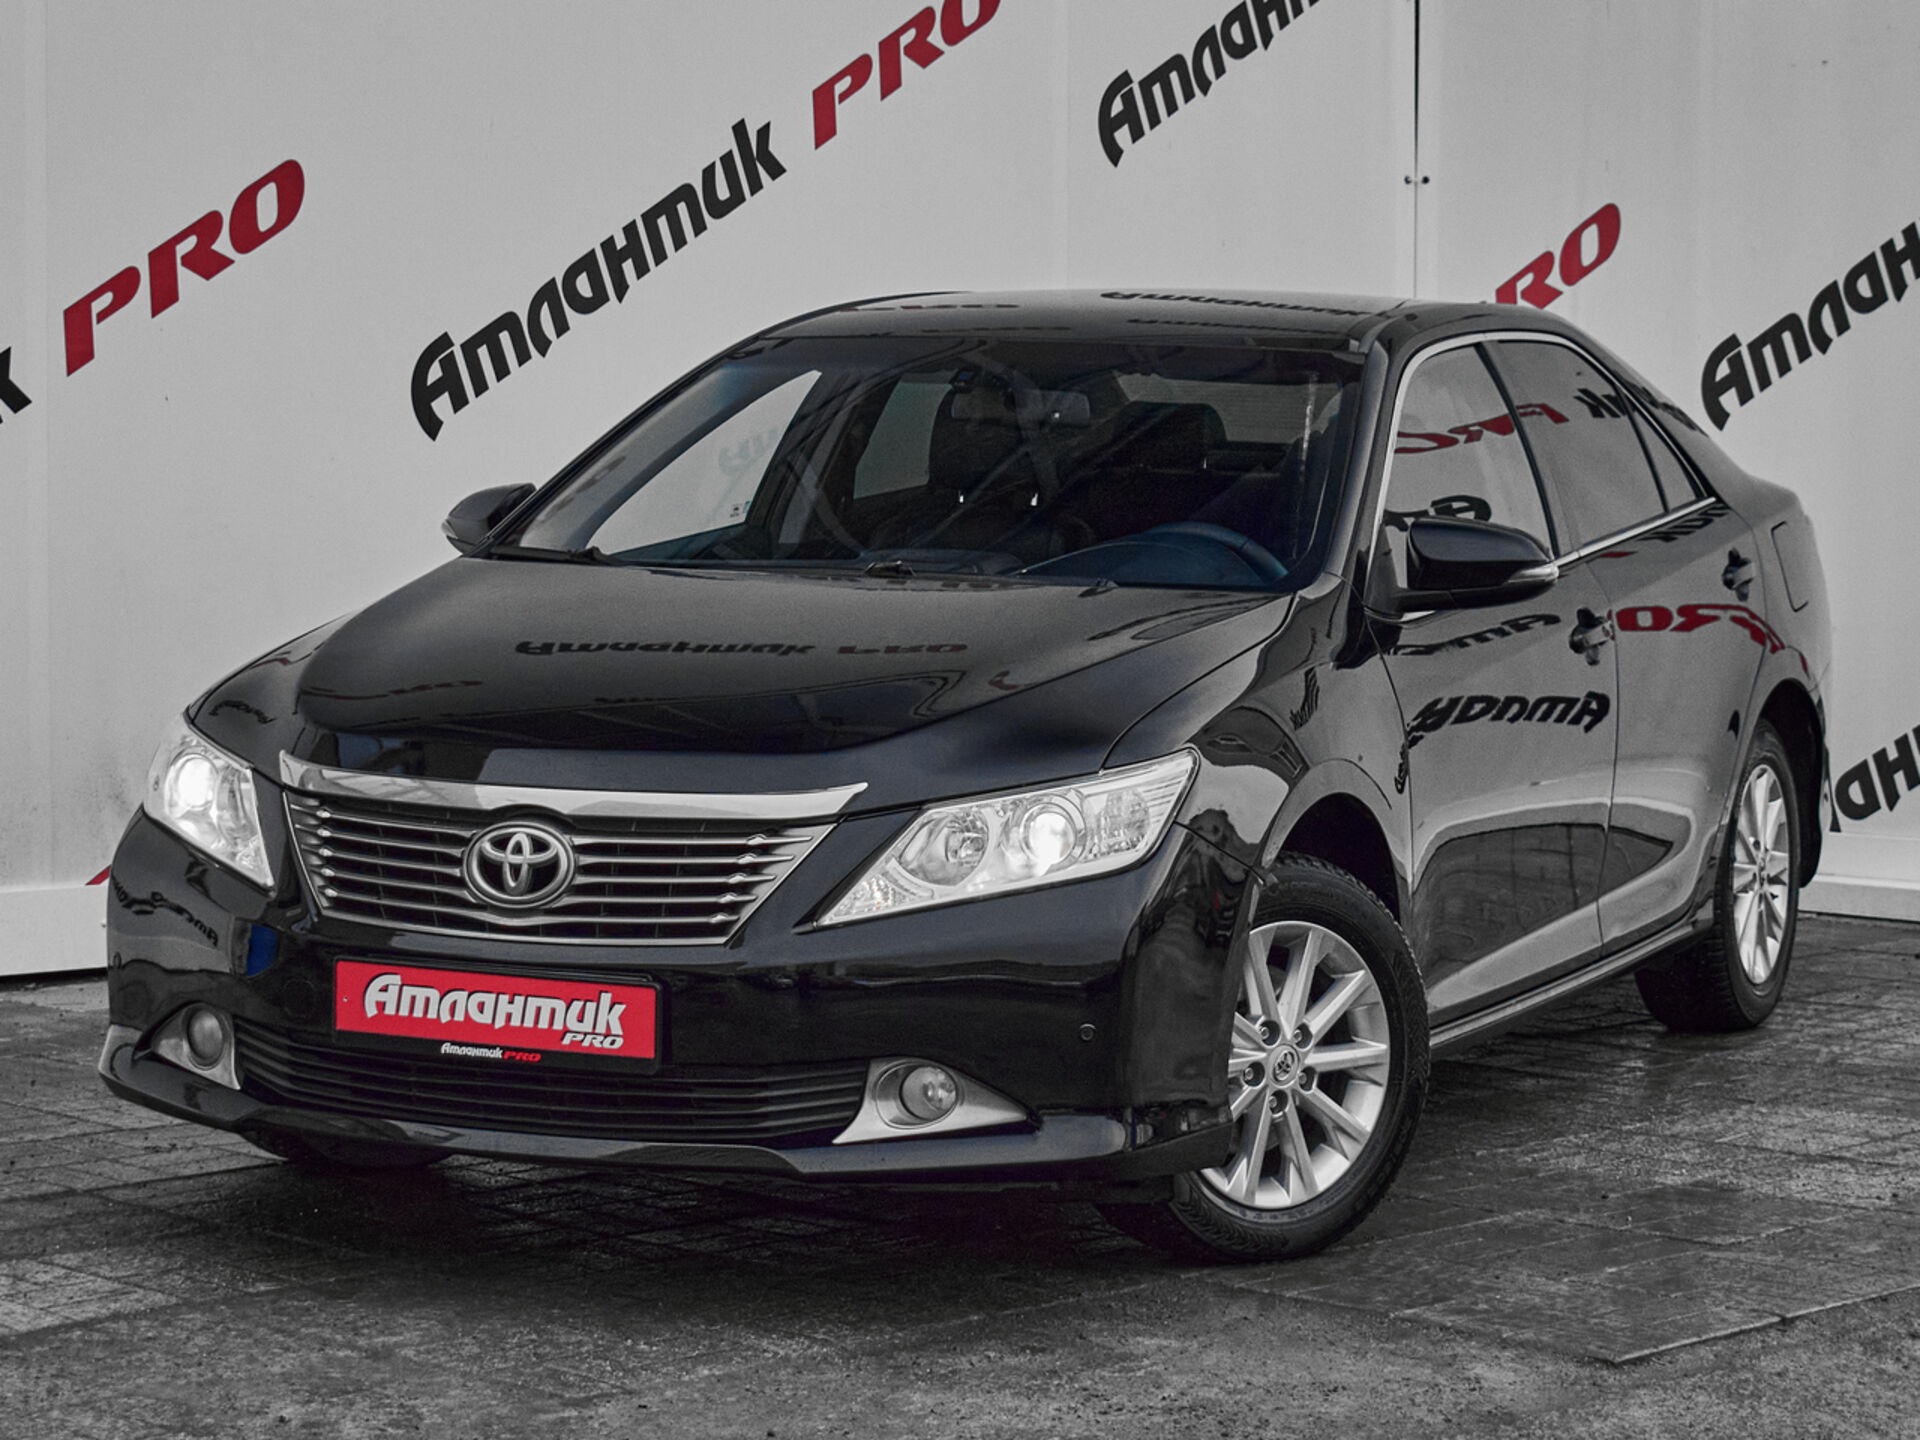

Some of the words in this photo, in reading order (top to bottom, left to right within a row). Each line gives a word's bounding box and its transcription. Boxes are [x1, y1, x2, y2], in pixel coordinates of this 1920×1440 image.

[812, 0, 1001, 150] PRO
[62, 158, 305, 377] PRO
[1495, 202, 1621, 310] RO
[503, 1051, 542, 1063] PRO
[561, 1032, 625, 1050] PRO
